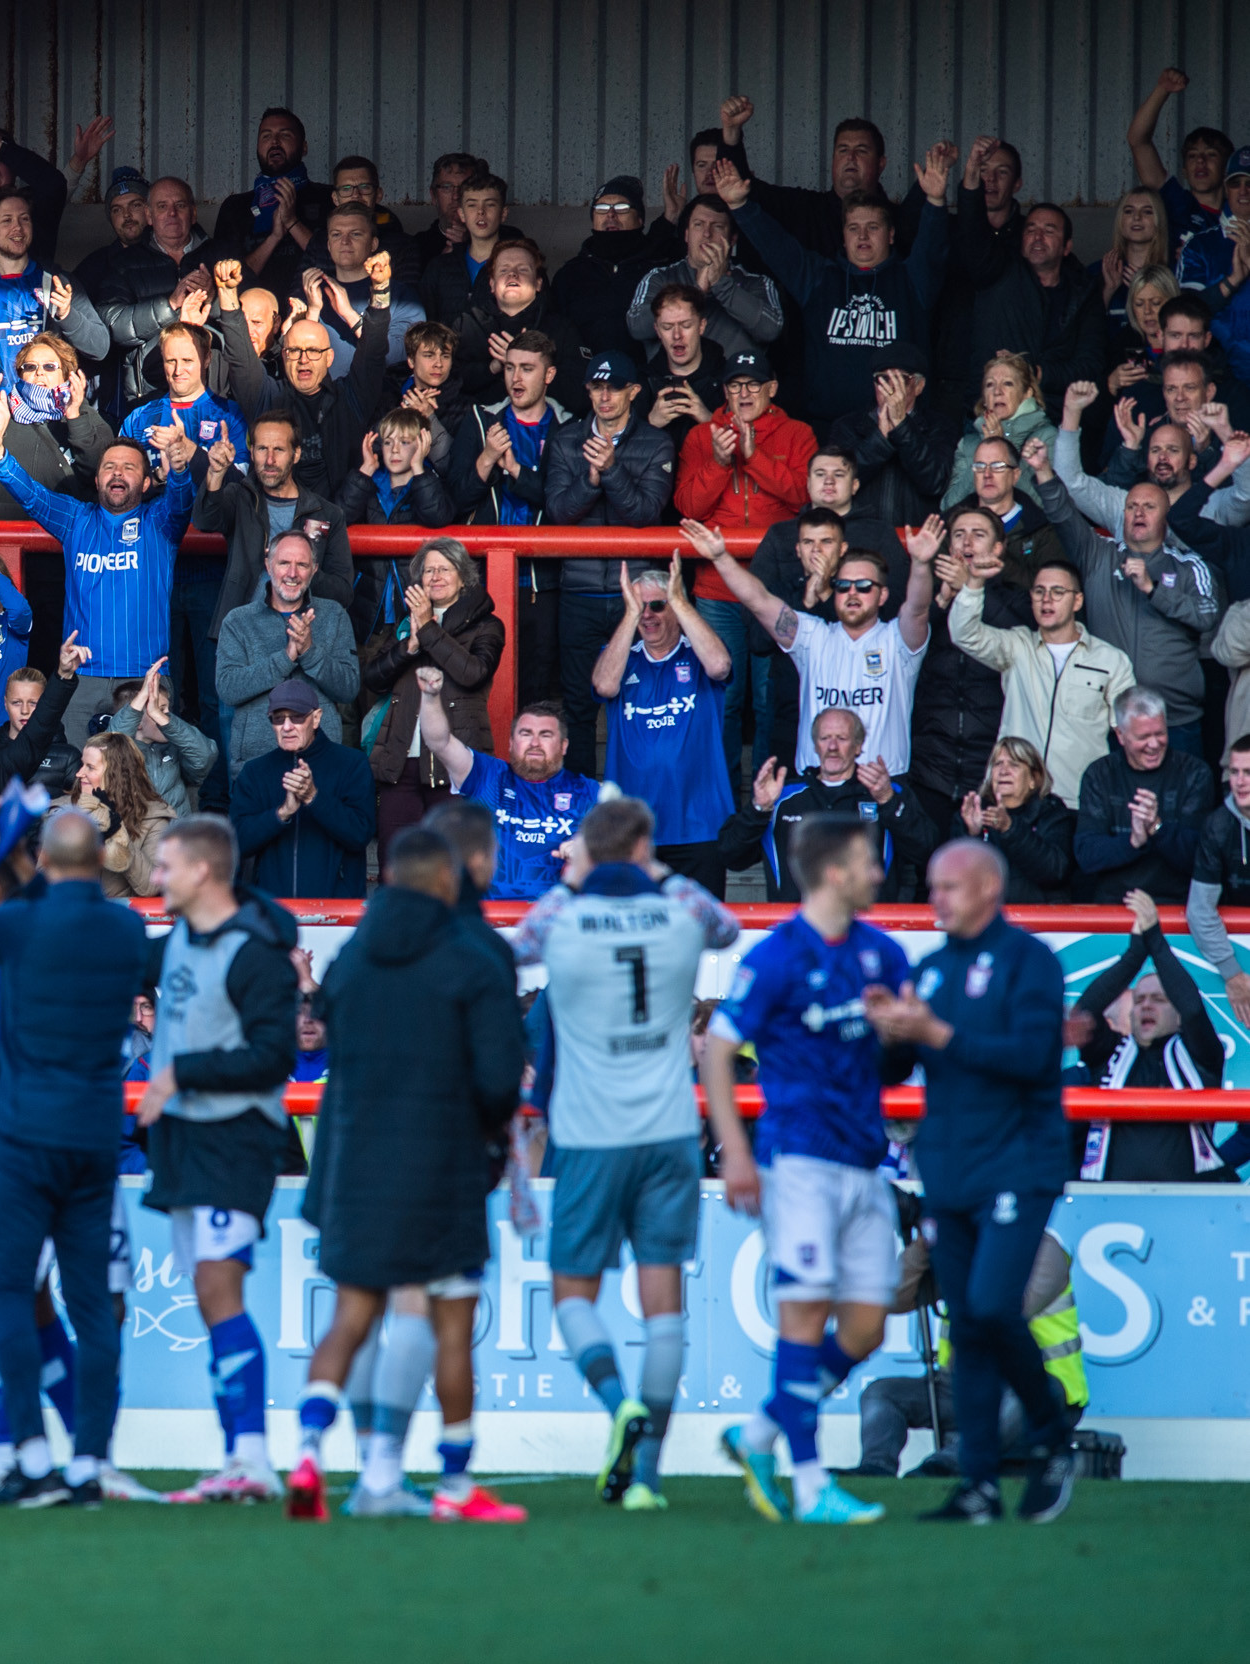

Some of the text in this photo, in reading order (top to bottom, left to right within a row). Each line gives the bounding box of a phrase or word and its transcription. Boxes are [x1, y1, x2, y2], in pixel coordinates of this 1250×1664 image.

[826, 307, 897, 340] IPSWICH
[74, 550, 139, 574] PIONEER
[815, 686, 883, 707] PIONEER
[613, 944, 649, 1025] 1
